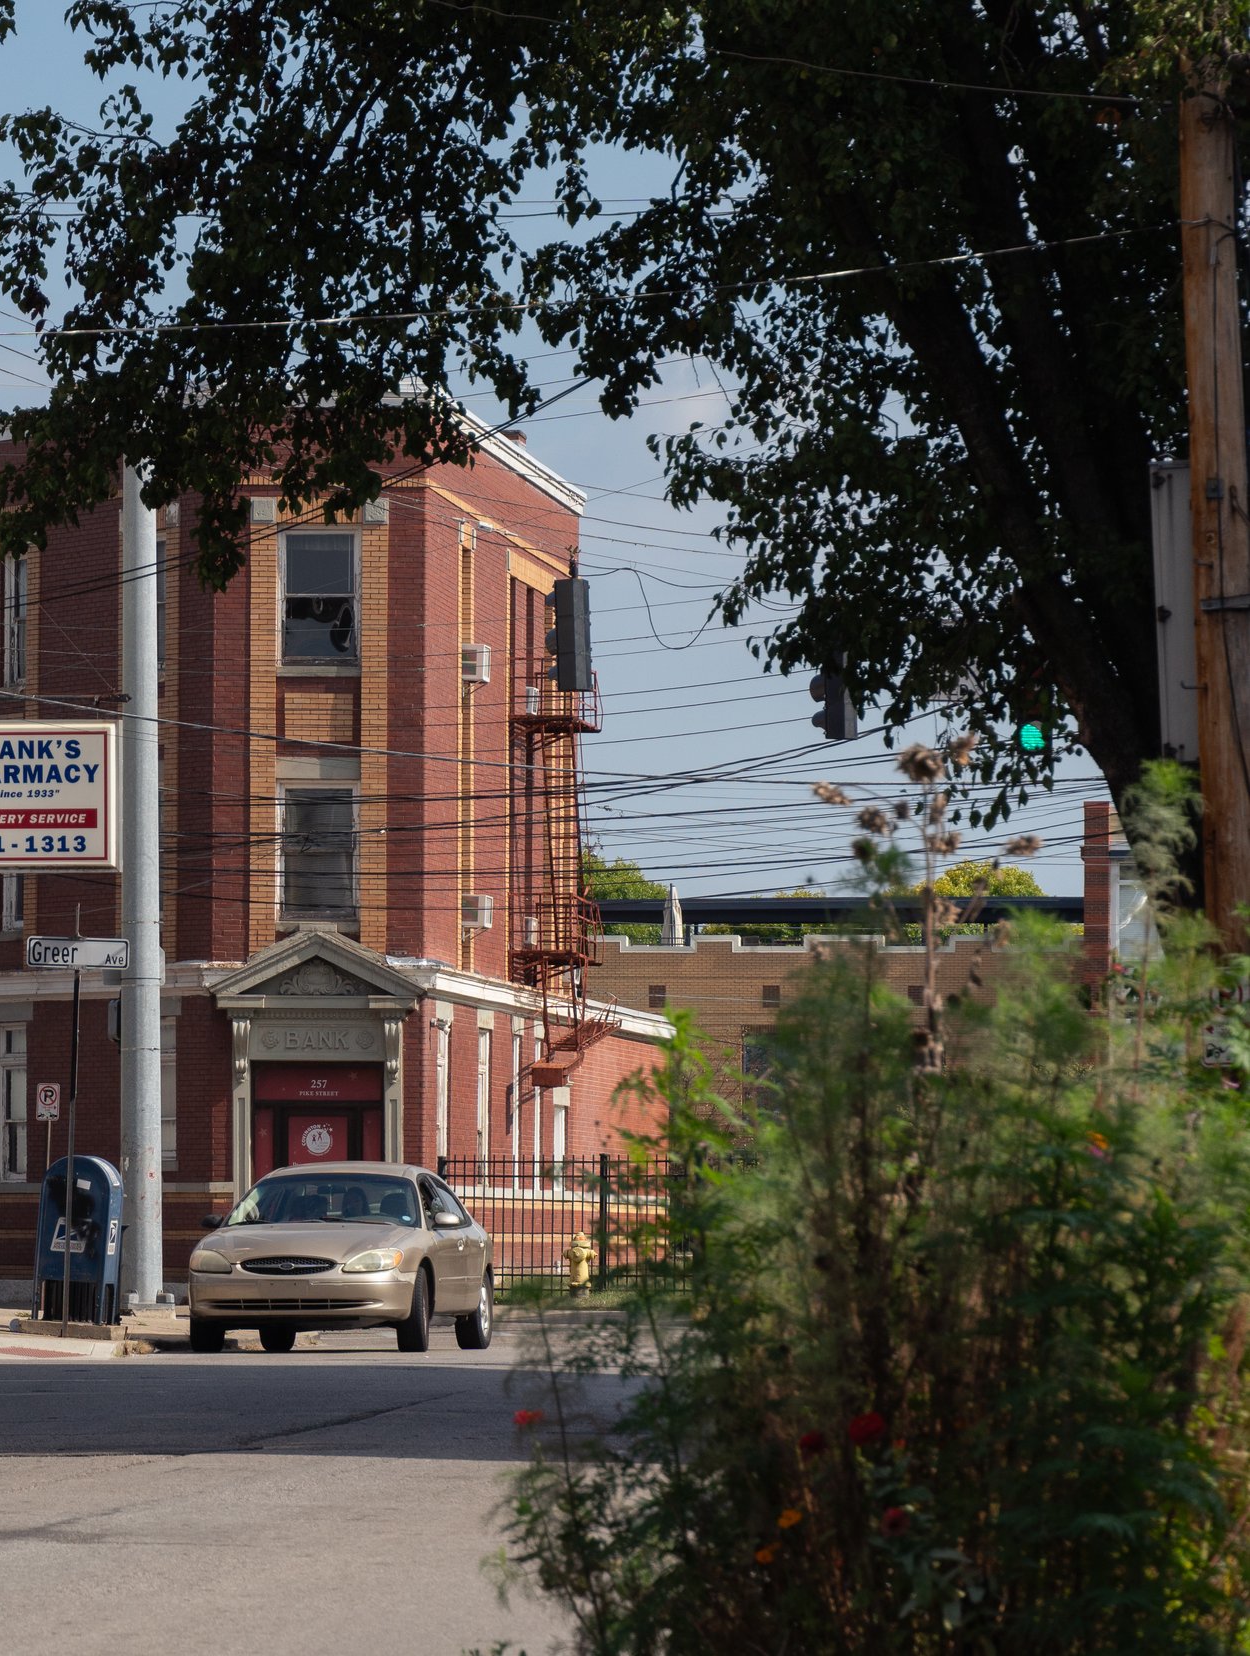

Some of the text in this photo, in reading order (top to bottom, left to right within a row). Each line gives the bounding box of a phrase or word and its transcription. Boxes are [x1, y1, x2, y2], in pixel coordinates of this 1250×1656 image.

[26, 789, 60, 799] 1933"
[29, 813, 87, 824] SERVICE
[32, 941, 124, 966] Greer Ave
[285, 1030, 351, 1050] BANK
[310, 1079, 327, 1089] 257
[301, 1124, 321, 1147] COVINGTON
